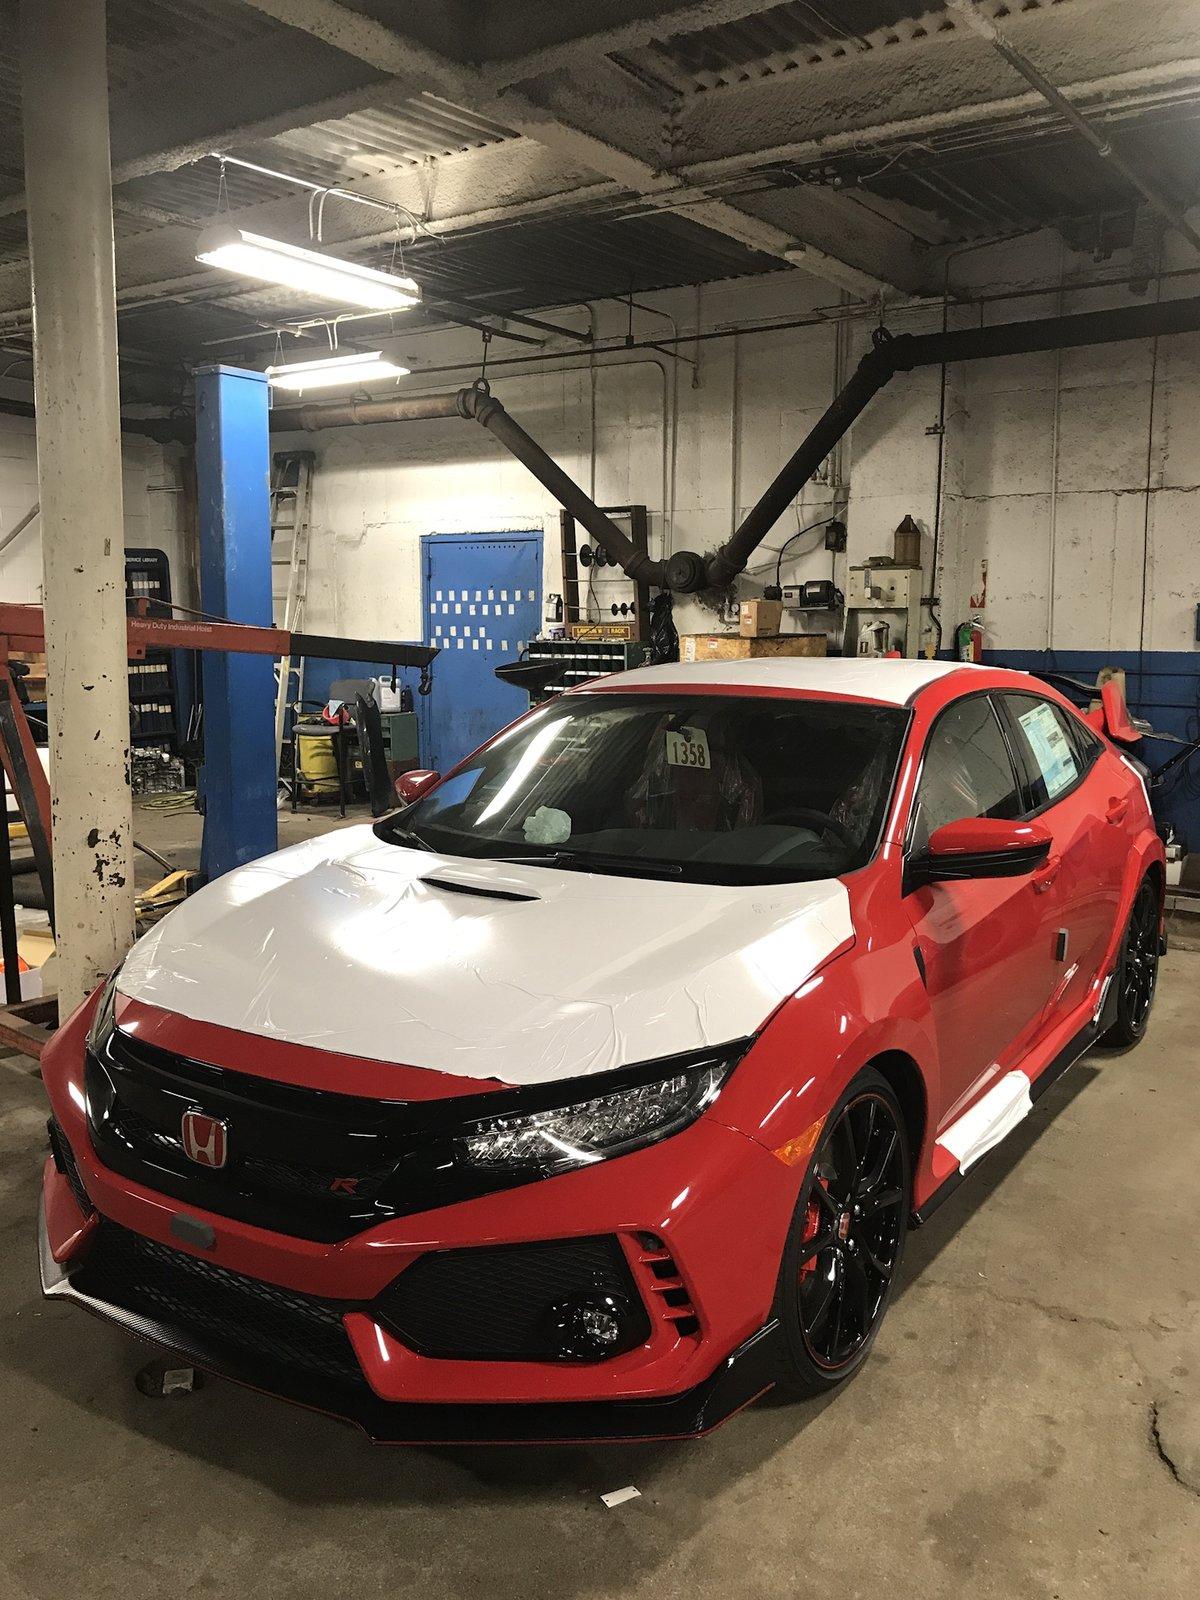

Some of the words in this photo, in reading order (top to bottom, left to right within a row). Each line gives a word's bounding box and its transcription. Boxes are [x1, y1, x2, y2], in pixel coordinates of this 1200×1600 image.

[131, 621, 152, 629] Heavy
[152, 622, 168, 630] Duty
[168, 623, 196, 631] Industrial
[672, 741, 706, 766] 1358
